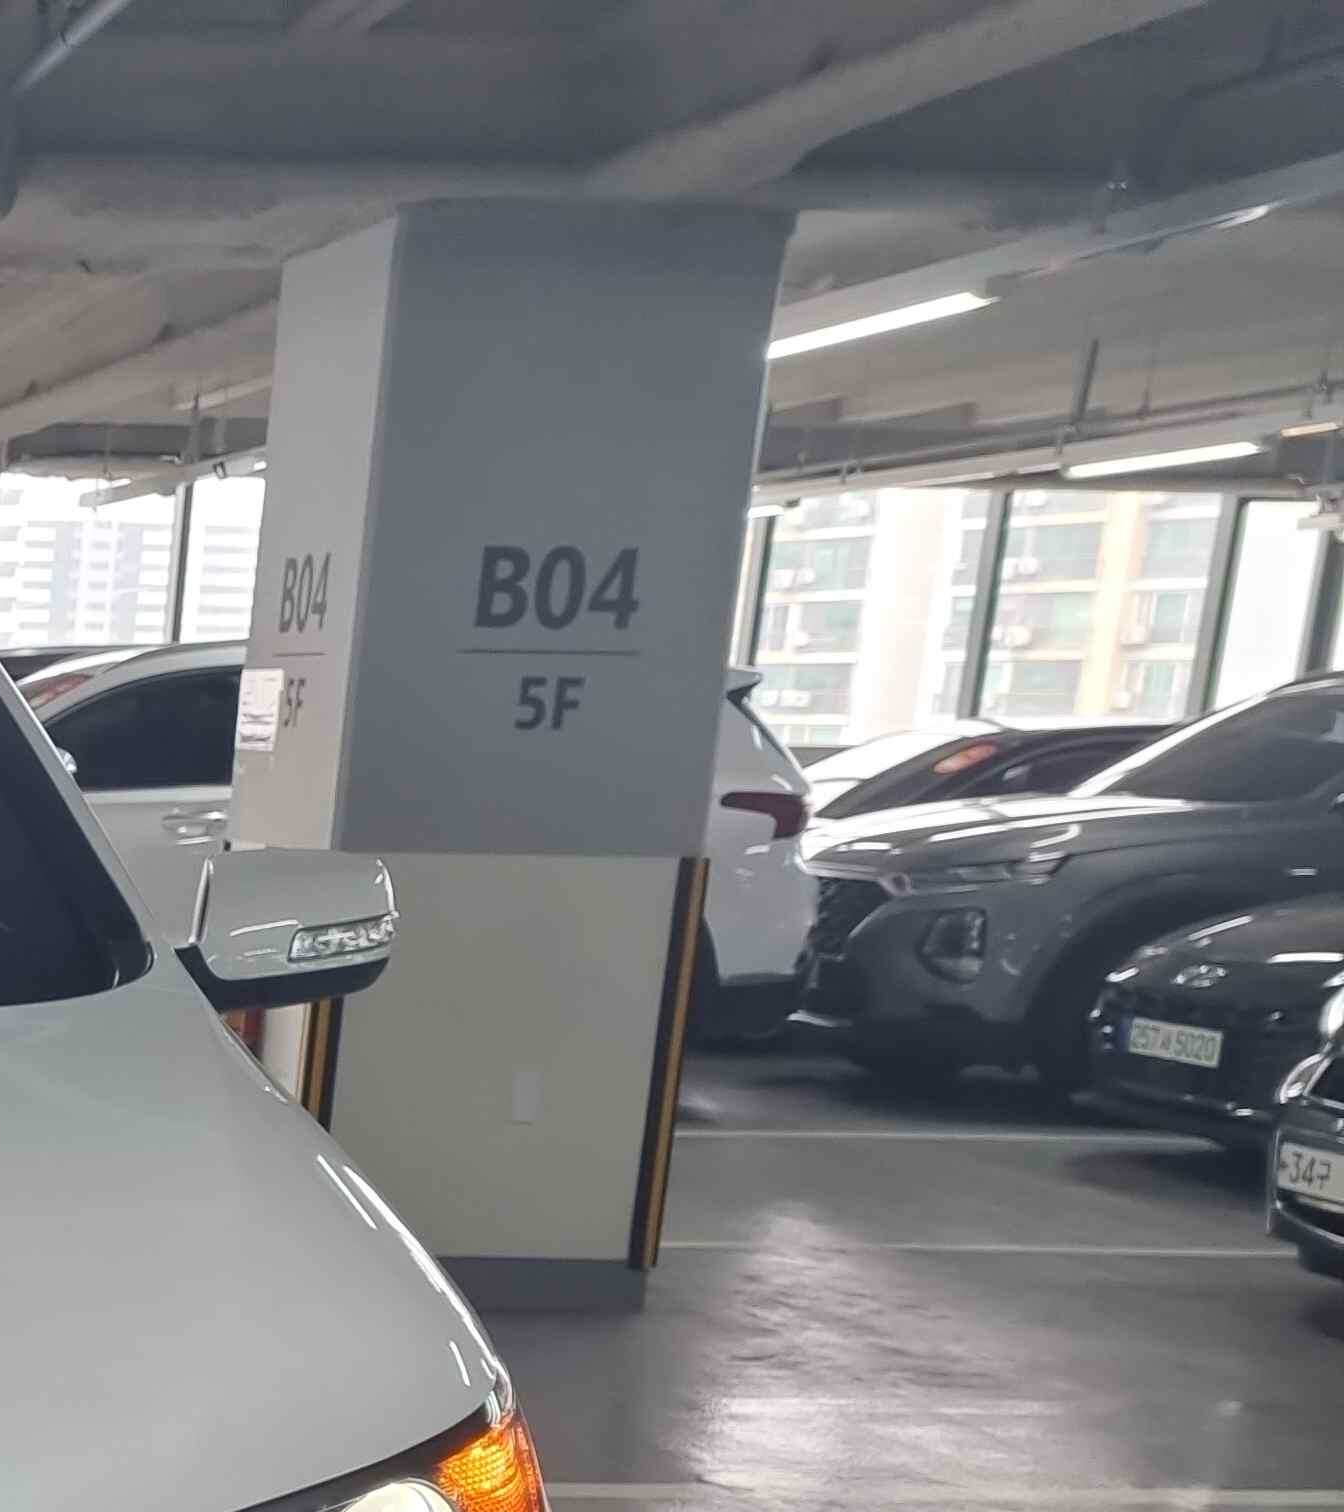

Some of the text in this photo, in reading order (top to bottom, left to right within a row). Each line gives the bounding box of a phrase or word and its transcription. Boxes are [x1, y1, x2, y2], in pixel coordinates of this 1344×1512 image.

[279, 552, 332, 633] B04
[474, 545, 640, 631] B04
[283, 677, 307, 729] 5F
[514, 676, 586, 731] 5F
